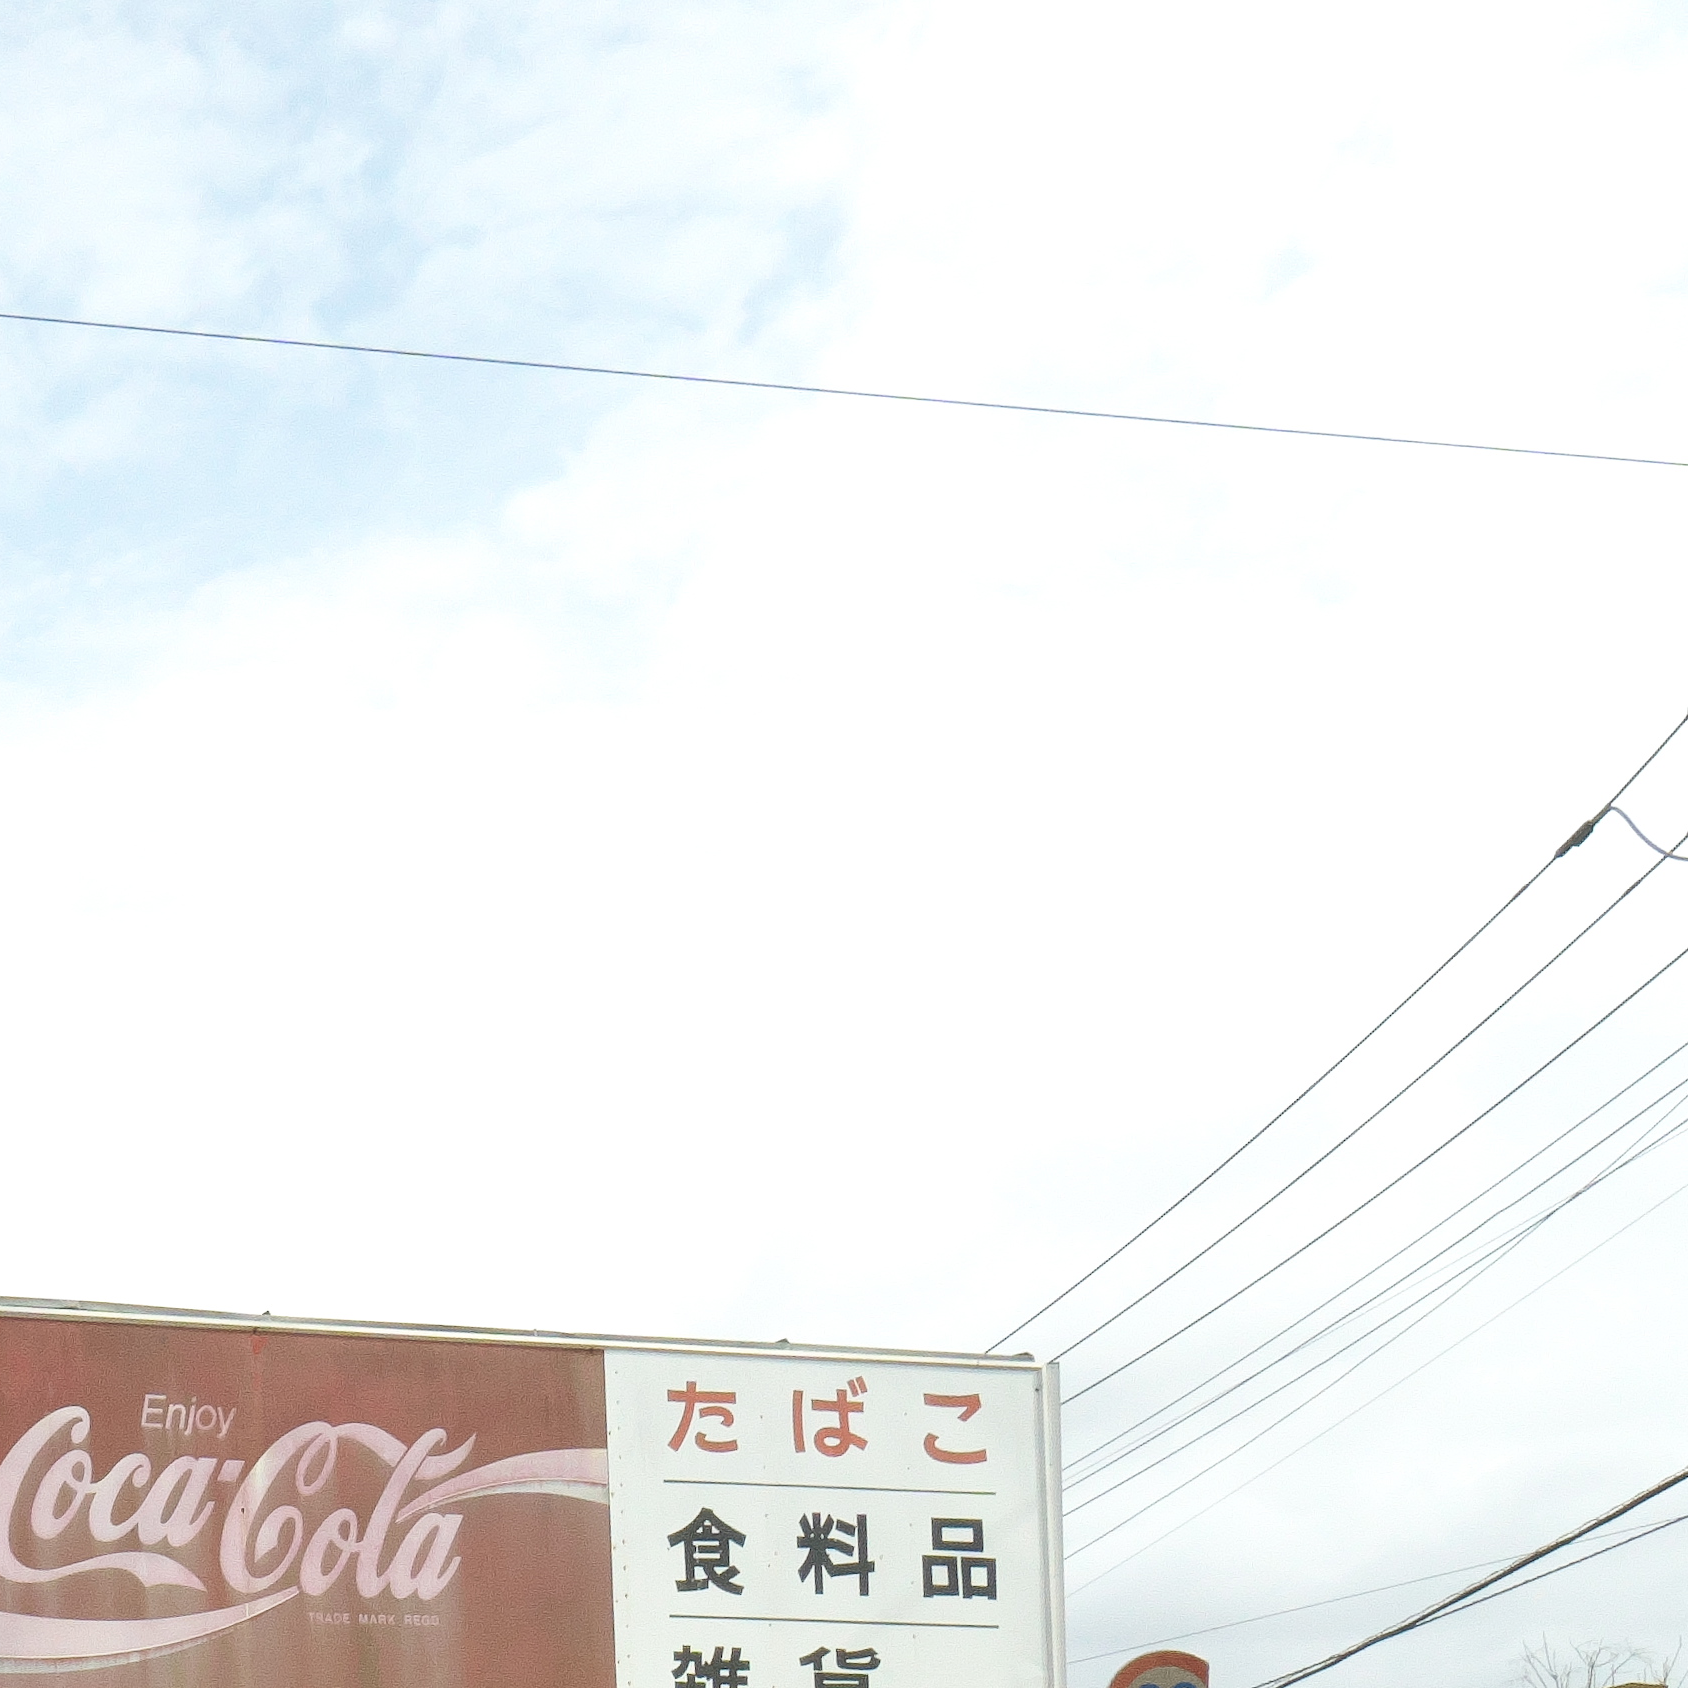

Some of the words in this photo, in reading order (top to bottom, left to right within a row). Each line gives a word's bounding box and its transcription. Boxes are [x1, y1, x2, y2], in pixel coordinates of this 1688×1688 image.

[141, 1394, 237, 1438] Enjoy
[666, 1376, 988, 1465] たばこ
[666, 1508, 997, 1600] 食料品
[308, 1612, 351, 1624] TRADE
[358, 1613, 396, 1625] MARK
